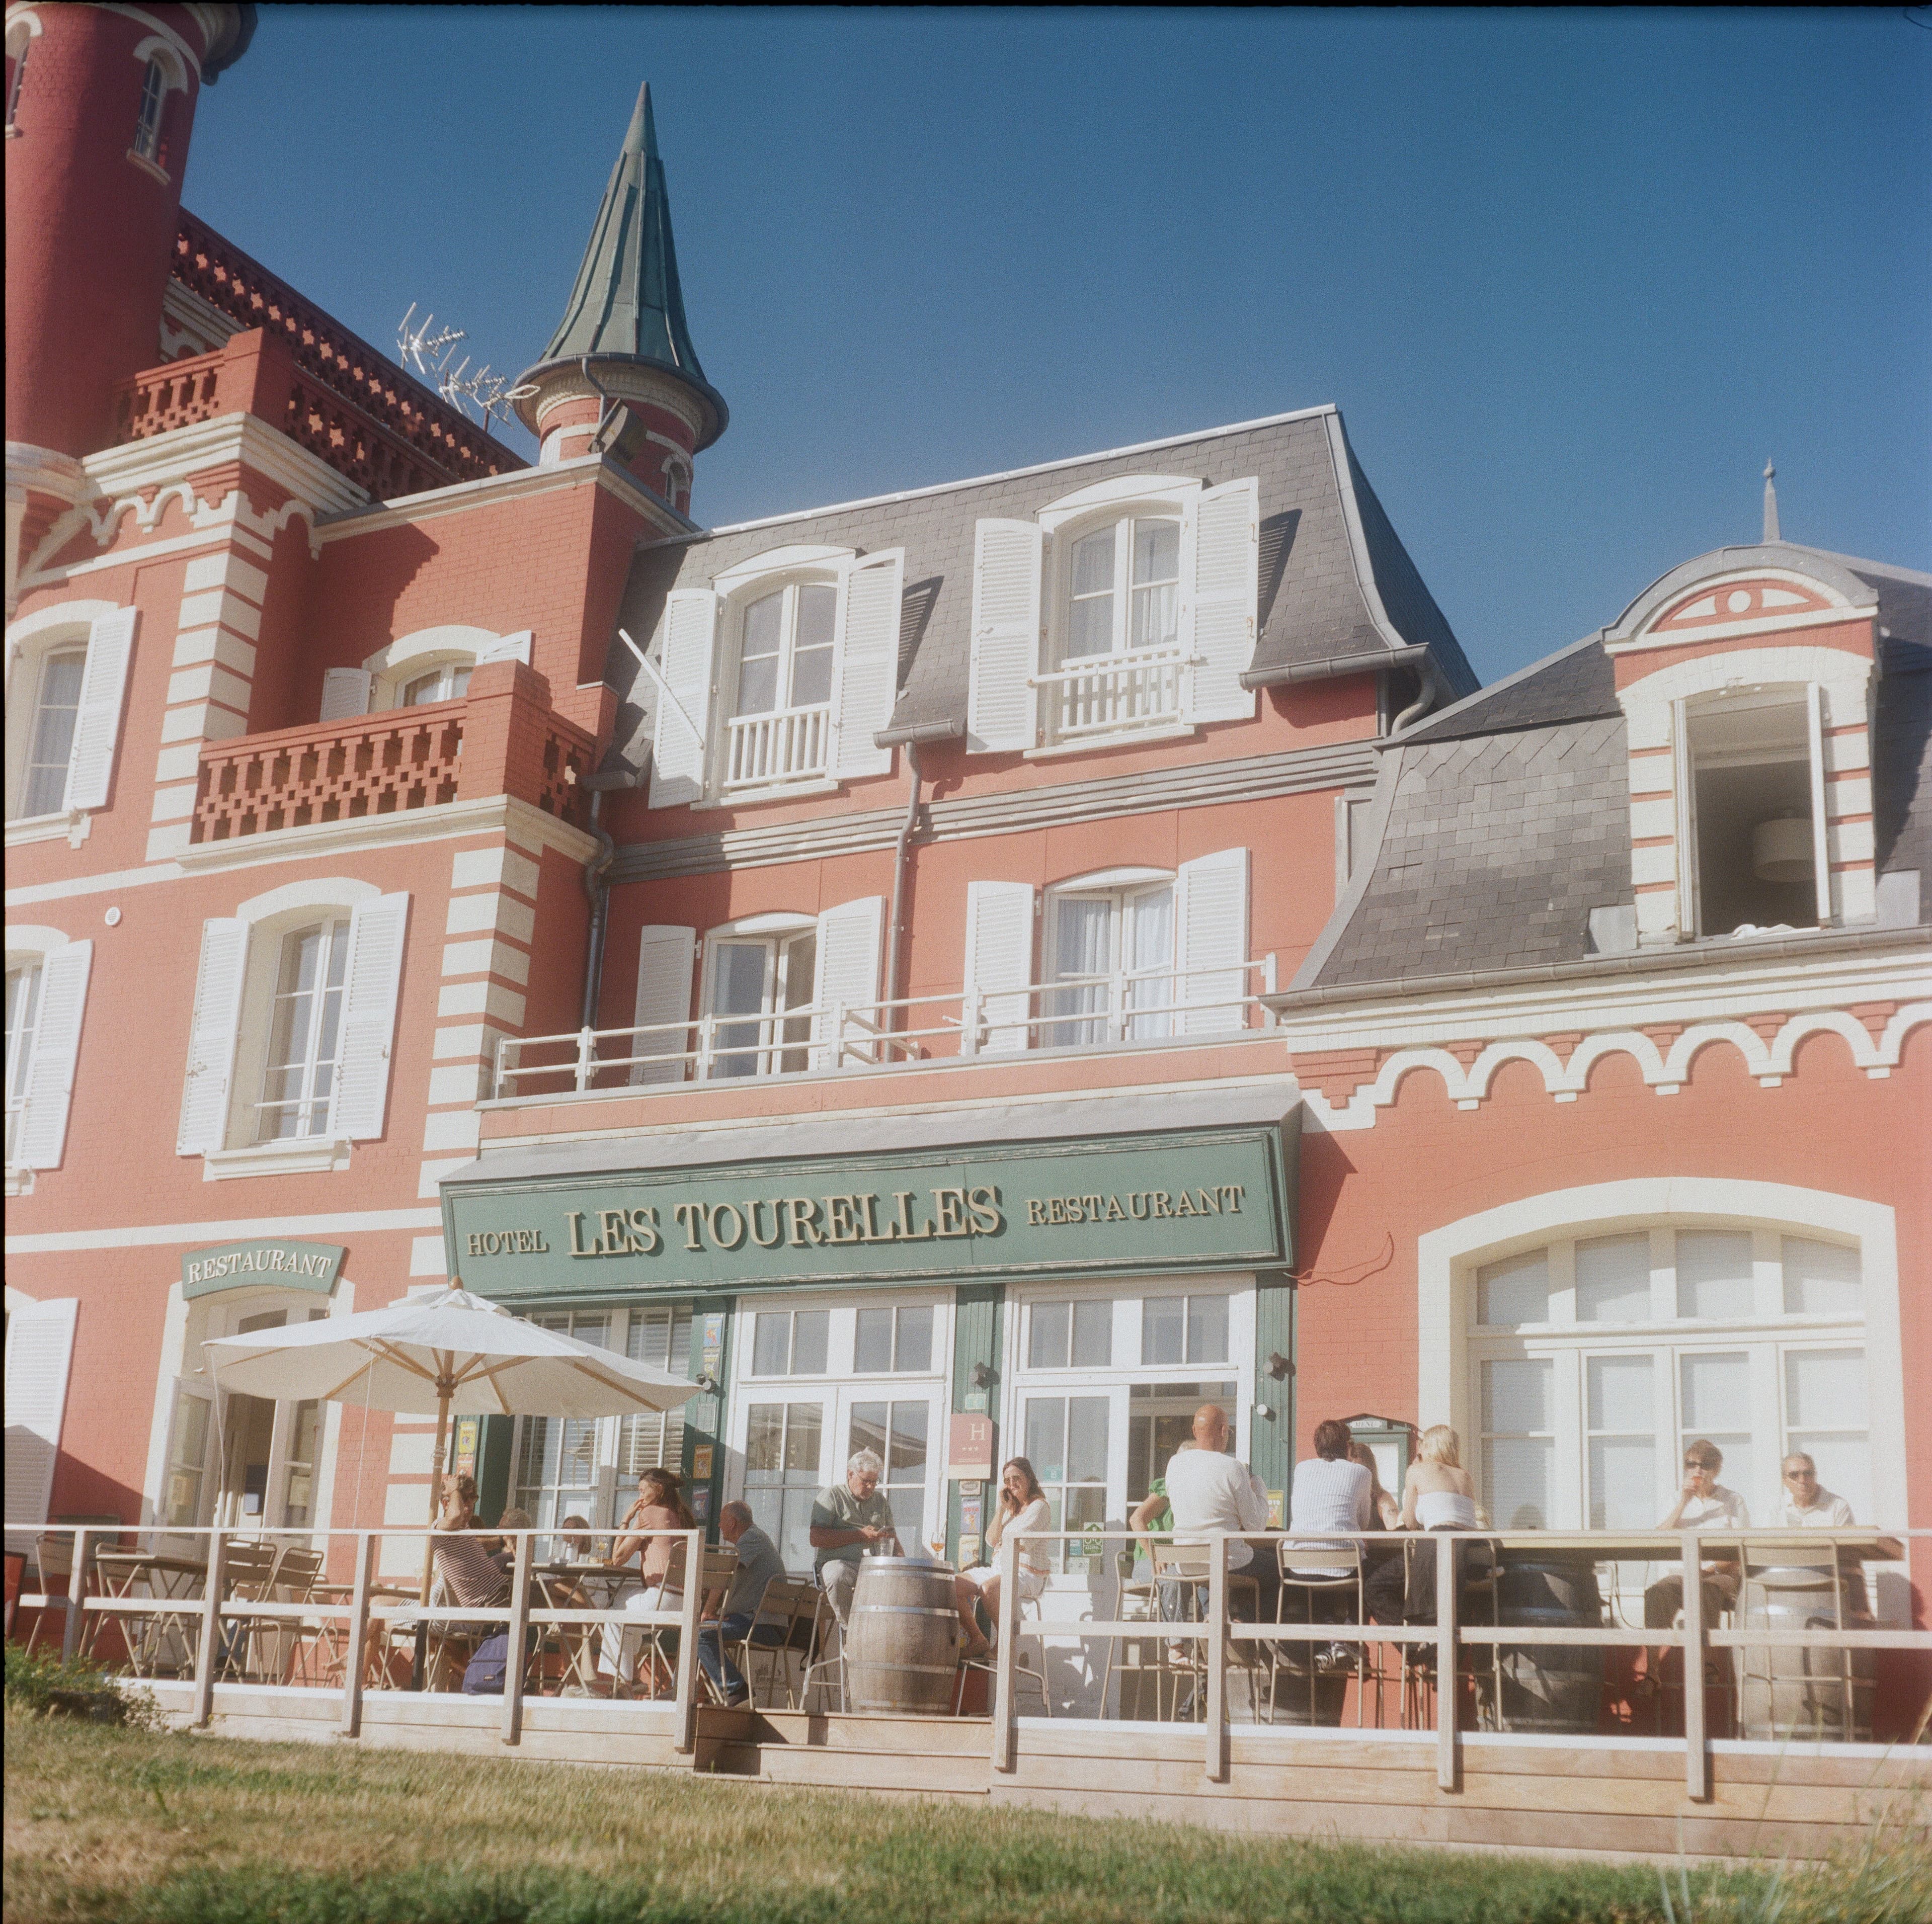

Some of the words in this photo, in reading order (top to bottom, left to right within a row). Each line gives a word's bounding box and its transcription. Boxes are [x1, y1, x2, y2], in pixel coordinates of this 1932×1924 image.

[466, 1229, 548, 1256] HOTEL
[564, 1207, 657, 1256] LES
[674, 1186, 1000, 1248] TOURELLES
[1025, 1185, 1243, 1224] RESTAURANT
[187, 1249, 333, 1284] RESTAURANT
[970, 1423, 985, 1441] H
